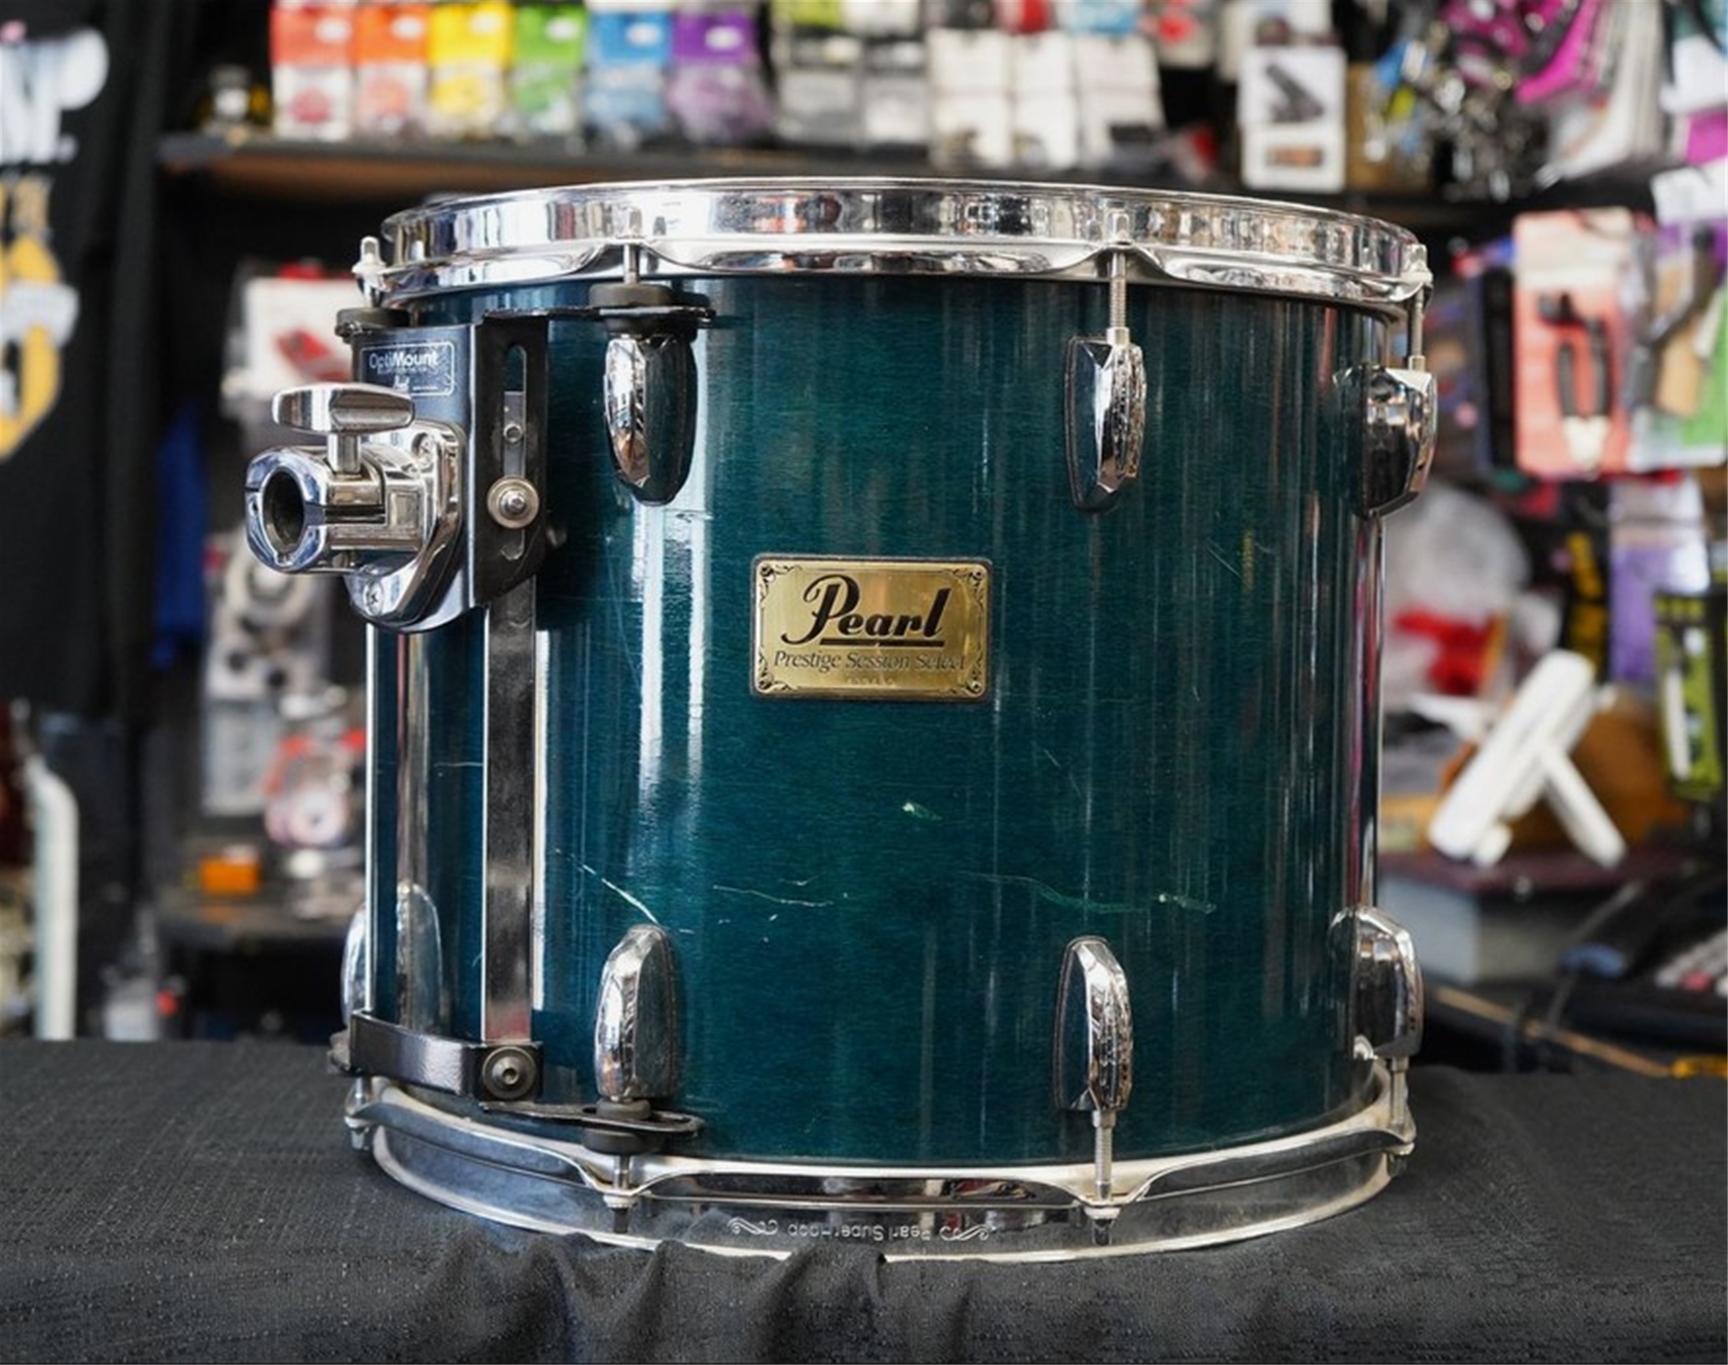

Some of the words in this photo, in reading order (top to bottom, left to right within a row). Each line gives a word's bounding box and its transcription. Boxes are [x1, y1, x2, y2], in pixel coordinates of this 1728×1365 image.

[369, 350, 439, 369] OptiMount
[781, 574, 952, 645] Pearl
[774, 651, 841, 673] Prestige
[846, 652, 910, 670] Session
[915, 653, 966, 671] Select
[889, 1223, 931, 1241] Pearl
